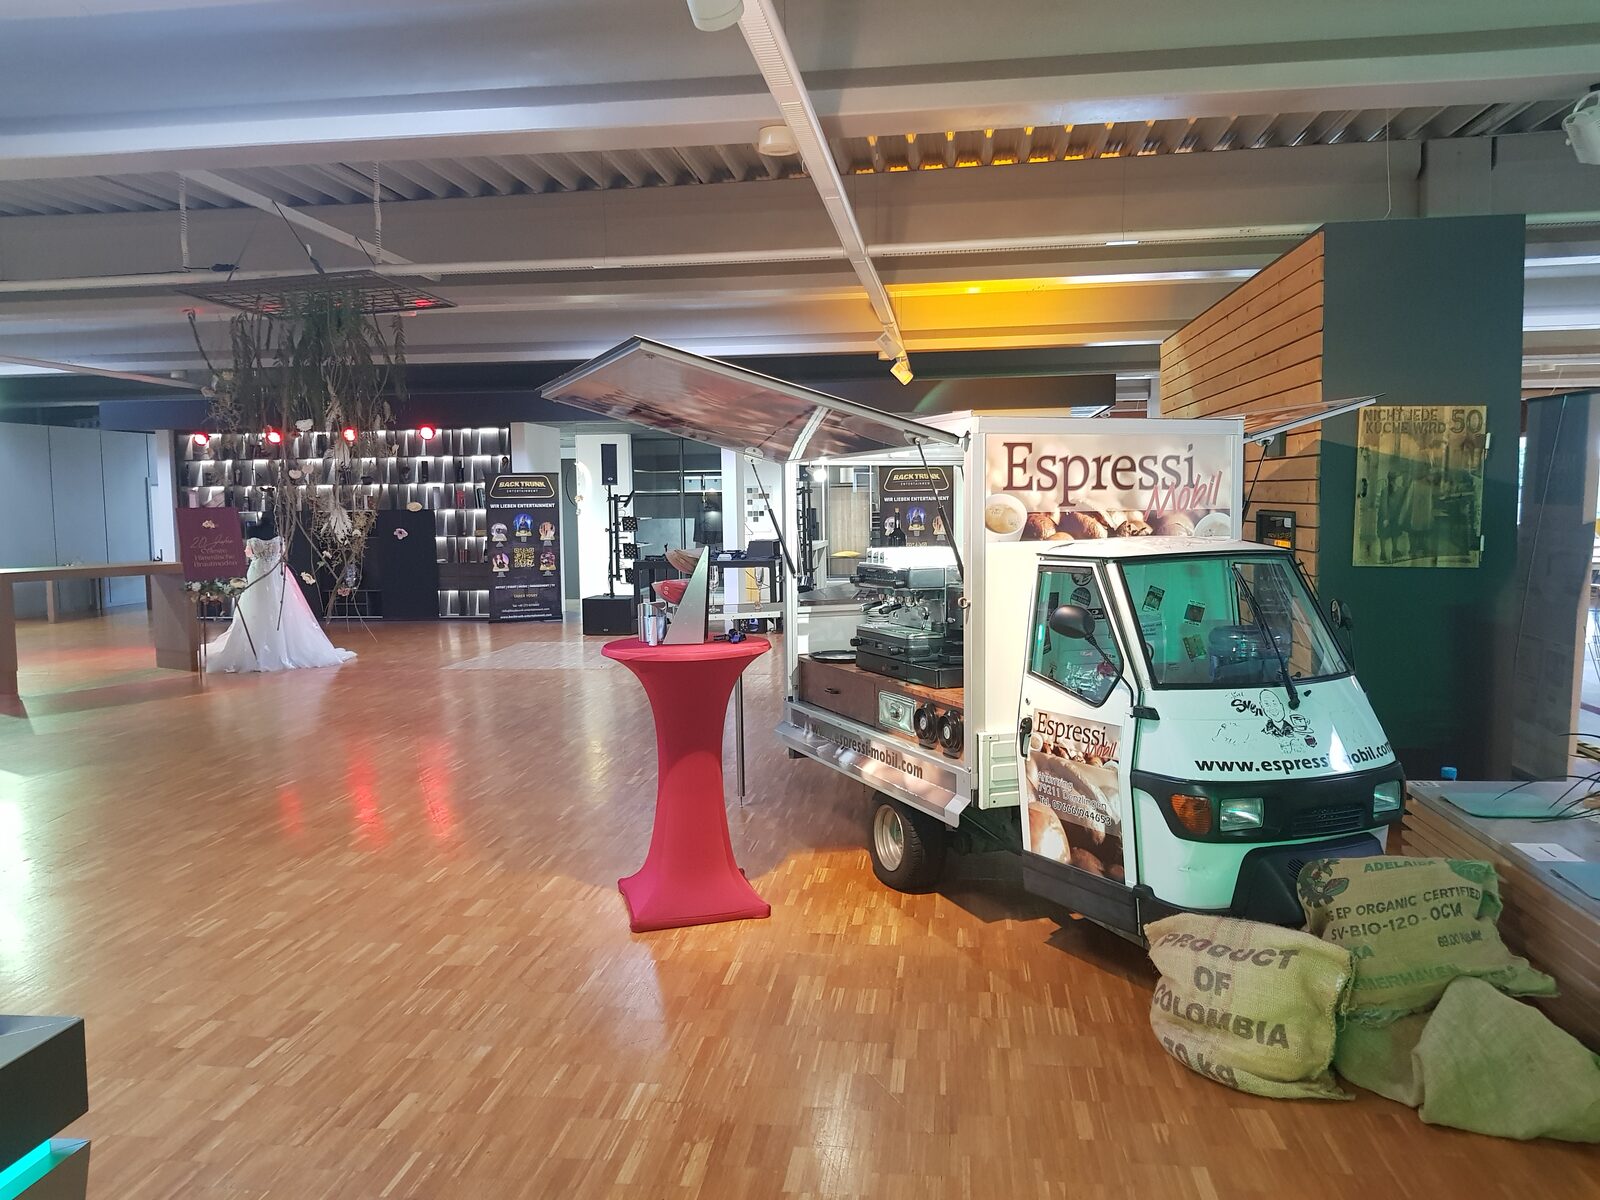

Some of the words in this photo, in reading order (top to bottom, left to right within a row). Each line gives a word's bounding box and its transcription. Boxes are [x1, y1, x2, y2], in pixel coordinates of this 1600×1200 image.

[1363, 408, 1405, 422] NICHT
[1406, 408, 1438, 422] JEDE
[1450, 409, 1483, 434] 50
[1002, 442, 1195, 507] Espressi
[1144, 470, 1222, 522] Mobil
[1231, 699, 1264, 717] Sven
[1038, 712, 1107, 745] Espressi
[1038, 794, 1052, 808] Tel.
[1336, 906, 1352, 920] EP
[1356, 895, 1418, 916] ORGANIC
[1423, 886, 1481, 902] CERTIFIED
[1159, 933, 1300, 970] PRODUCT
[1193, 965, 1232, 997] OF
[1153, 983, 1290, 1049] COLOMBIA
